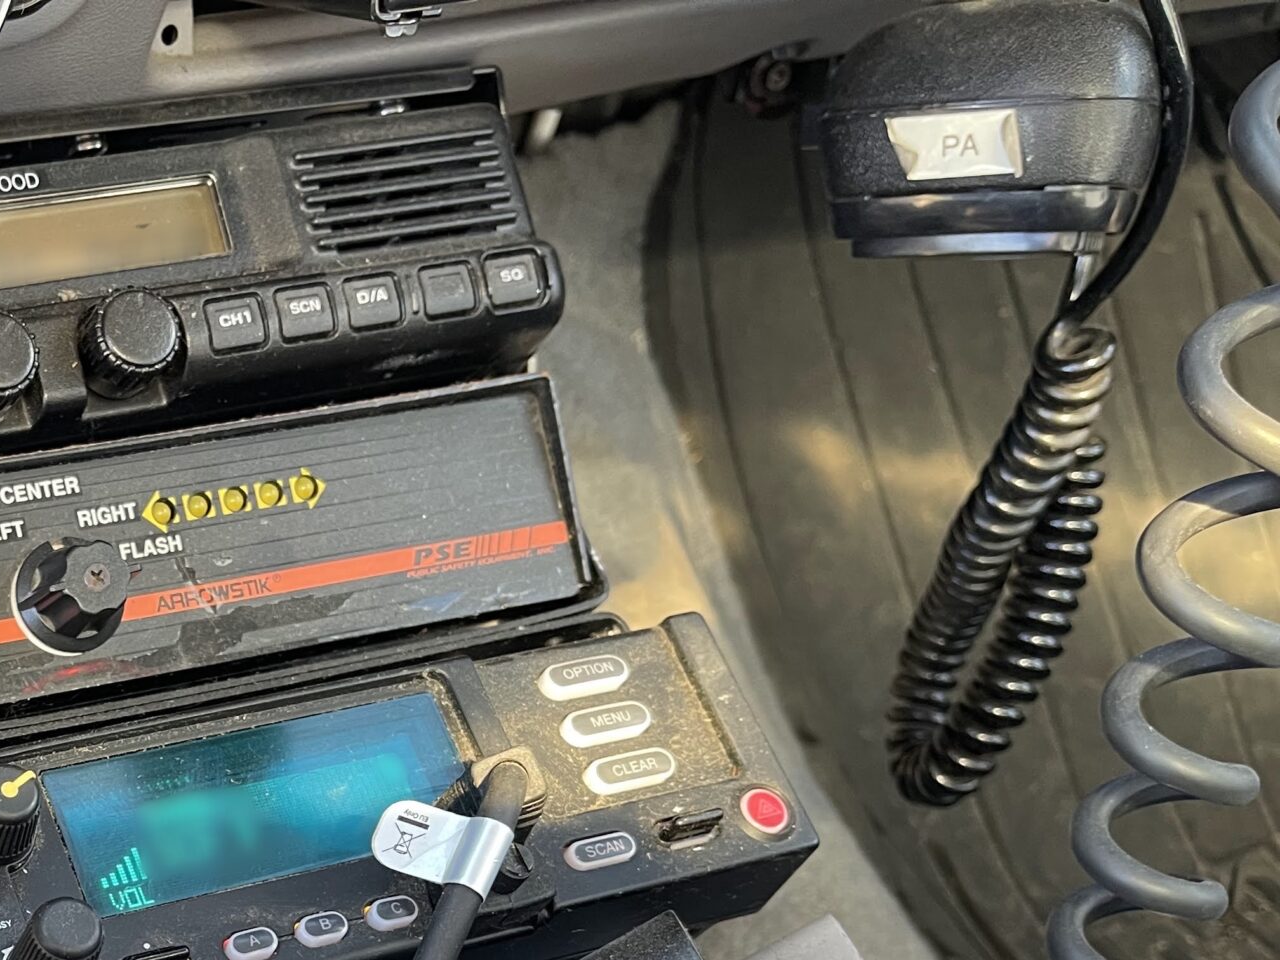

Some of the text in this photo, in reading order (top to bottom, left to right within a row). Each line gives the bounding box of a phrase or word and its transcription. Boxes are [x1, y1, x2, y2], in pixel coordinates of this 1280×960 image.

[942, 133, 979, 158] PA
[356, 288, 388, 305] D/A
[289, 298, 321, 315] SCN
[218, 310, 252, 329] CH1
[0, 475, 81, 506] CENTER
[76, 501, 137, 528] RIGHT
[119, 534, 184, 561] FLASH
[414, 539, 472, 566] PSE
[563, 661, 614, 680] OPTION
[590, 709, 632, 728] MENU
[611, 757, 659, 778] CLEAR
[584, 838, 625, 858] SCAN
[109, 886, 155, 909] VOL
[390, 902, 402, 914] C
[320, 918, 332, 930] B
[249, 934, 261, 947] A
